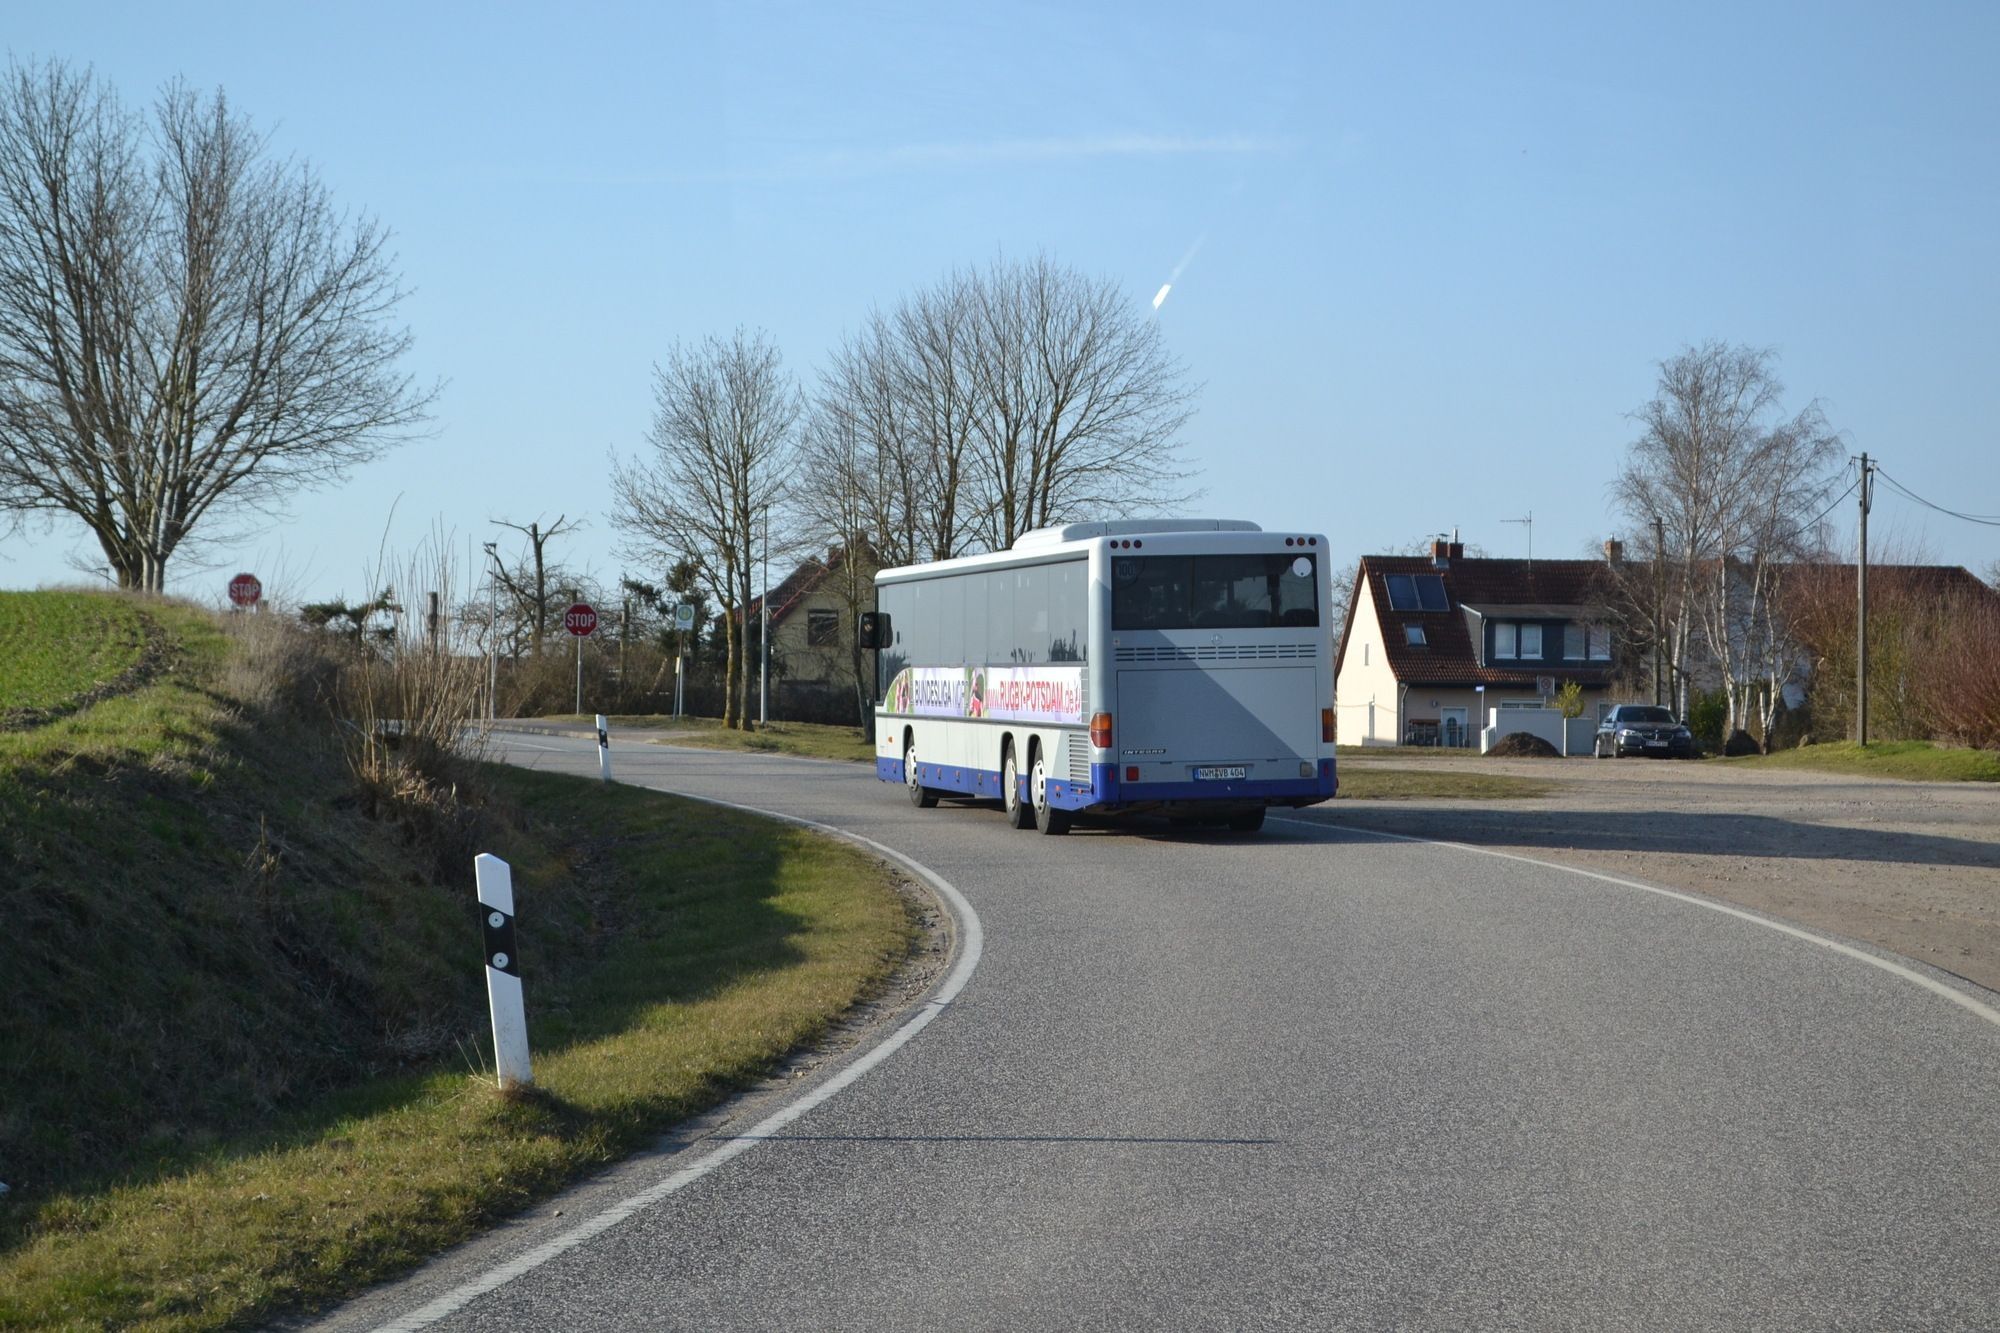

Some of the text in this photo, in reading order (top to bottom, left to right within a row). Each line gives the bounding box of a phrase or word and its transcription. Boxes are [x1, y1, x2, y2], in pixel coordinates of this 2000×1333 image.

[1118, 563, 1134, 577] 100
[231, 583, 259, 598] STOP
[567, 613, 595, 628] STOP
[914, 680, 952, 709] BUNDESLIGA
